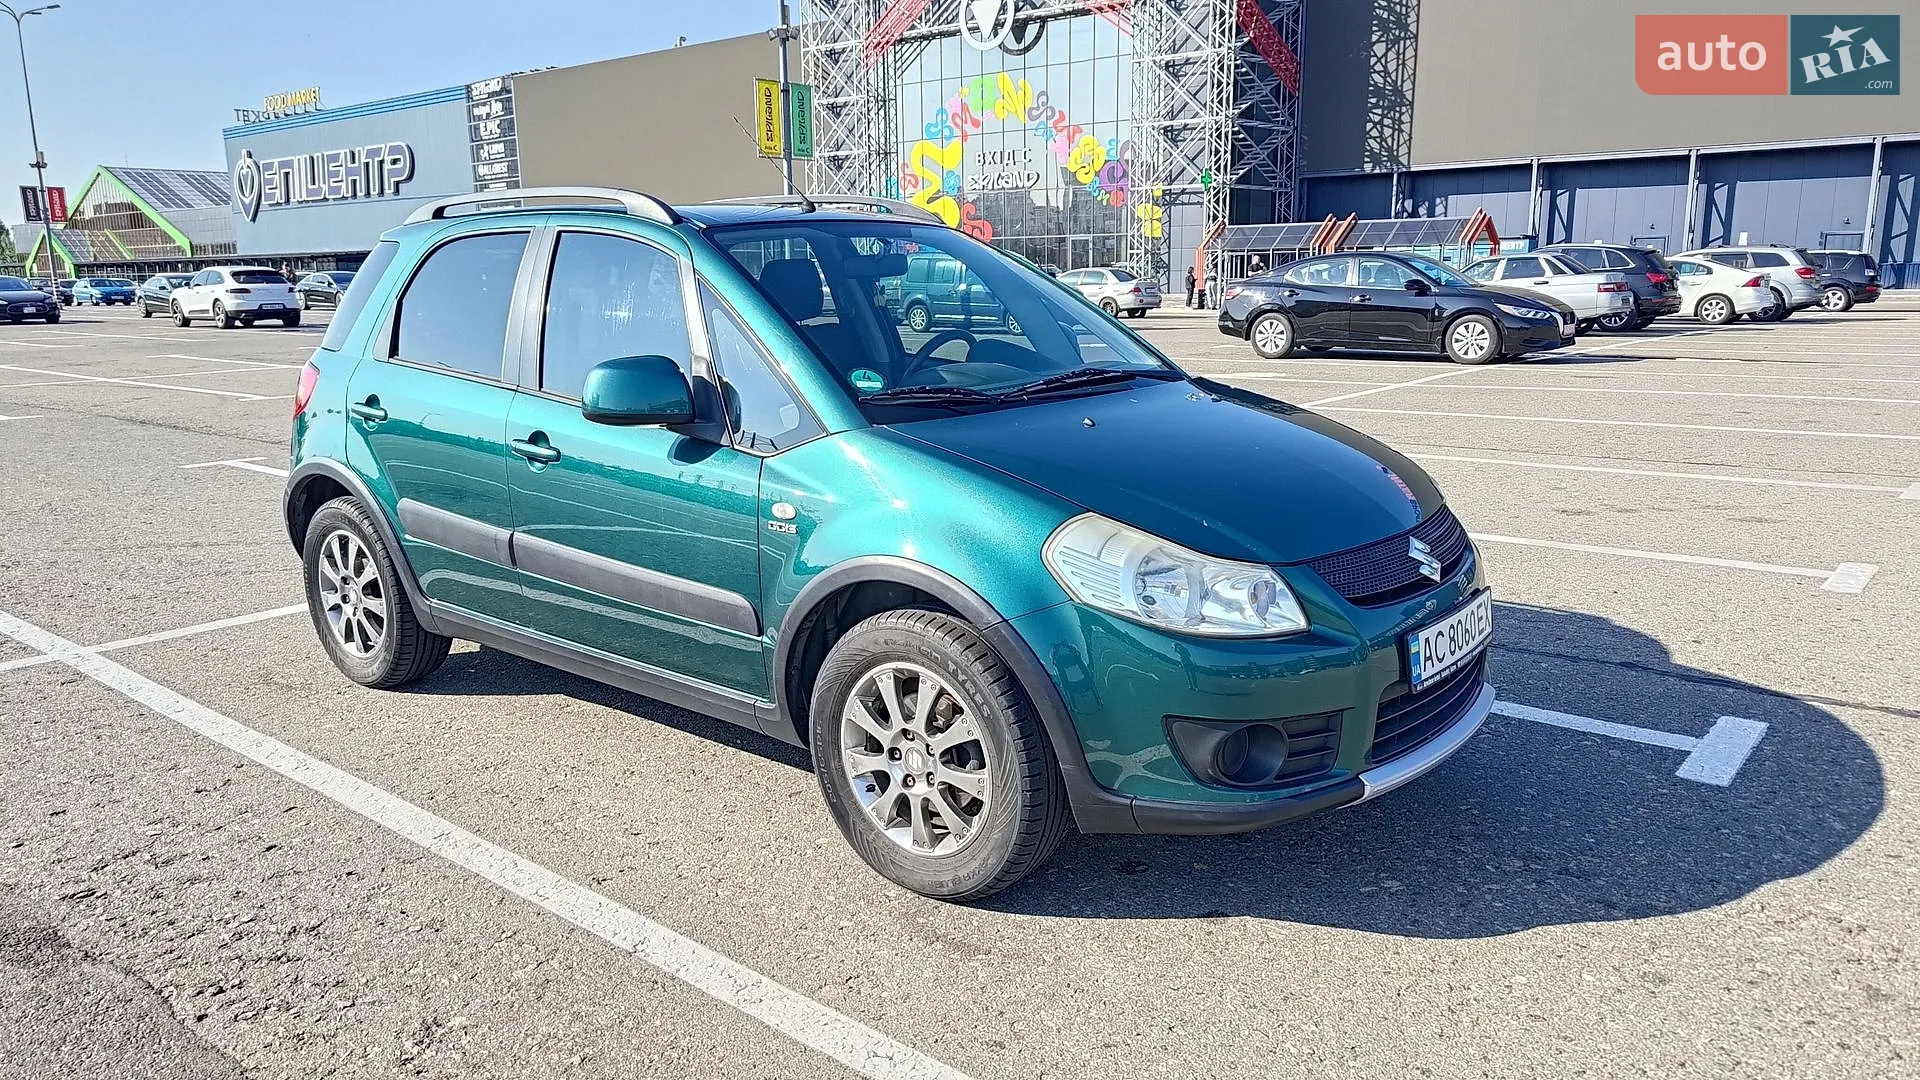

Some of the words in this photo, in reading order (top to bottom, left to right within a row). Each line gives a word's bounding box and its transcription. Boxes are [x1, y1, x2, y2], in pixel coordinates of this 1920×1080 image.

[263, 94, 287, 112] FOOD
[287, 87, 320, 106] MARKET
[976, 150, 1016, 166] ВХІД
[260, 142, 412, 204] ЕПІЦЕНТР
[862, 371, 872, 381] 4
[1423, 630, 1446, 672] AC
[1412, 664, 1421, 677] UA
